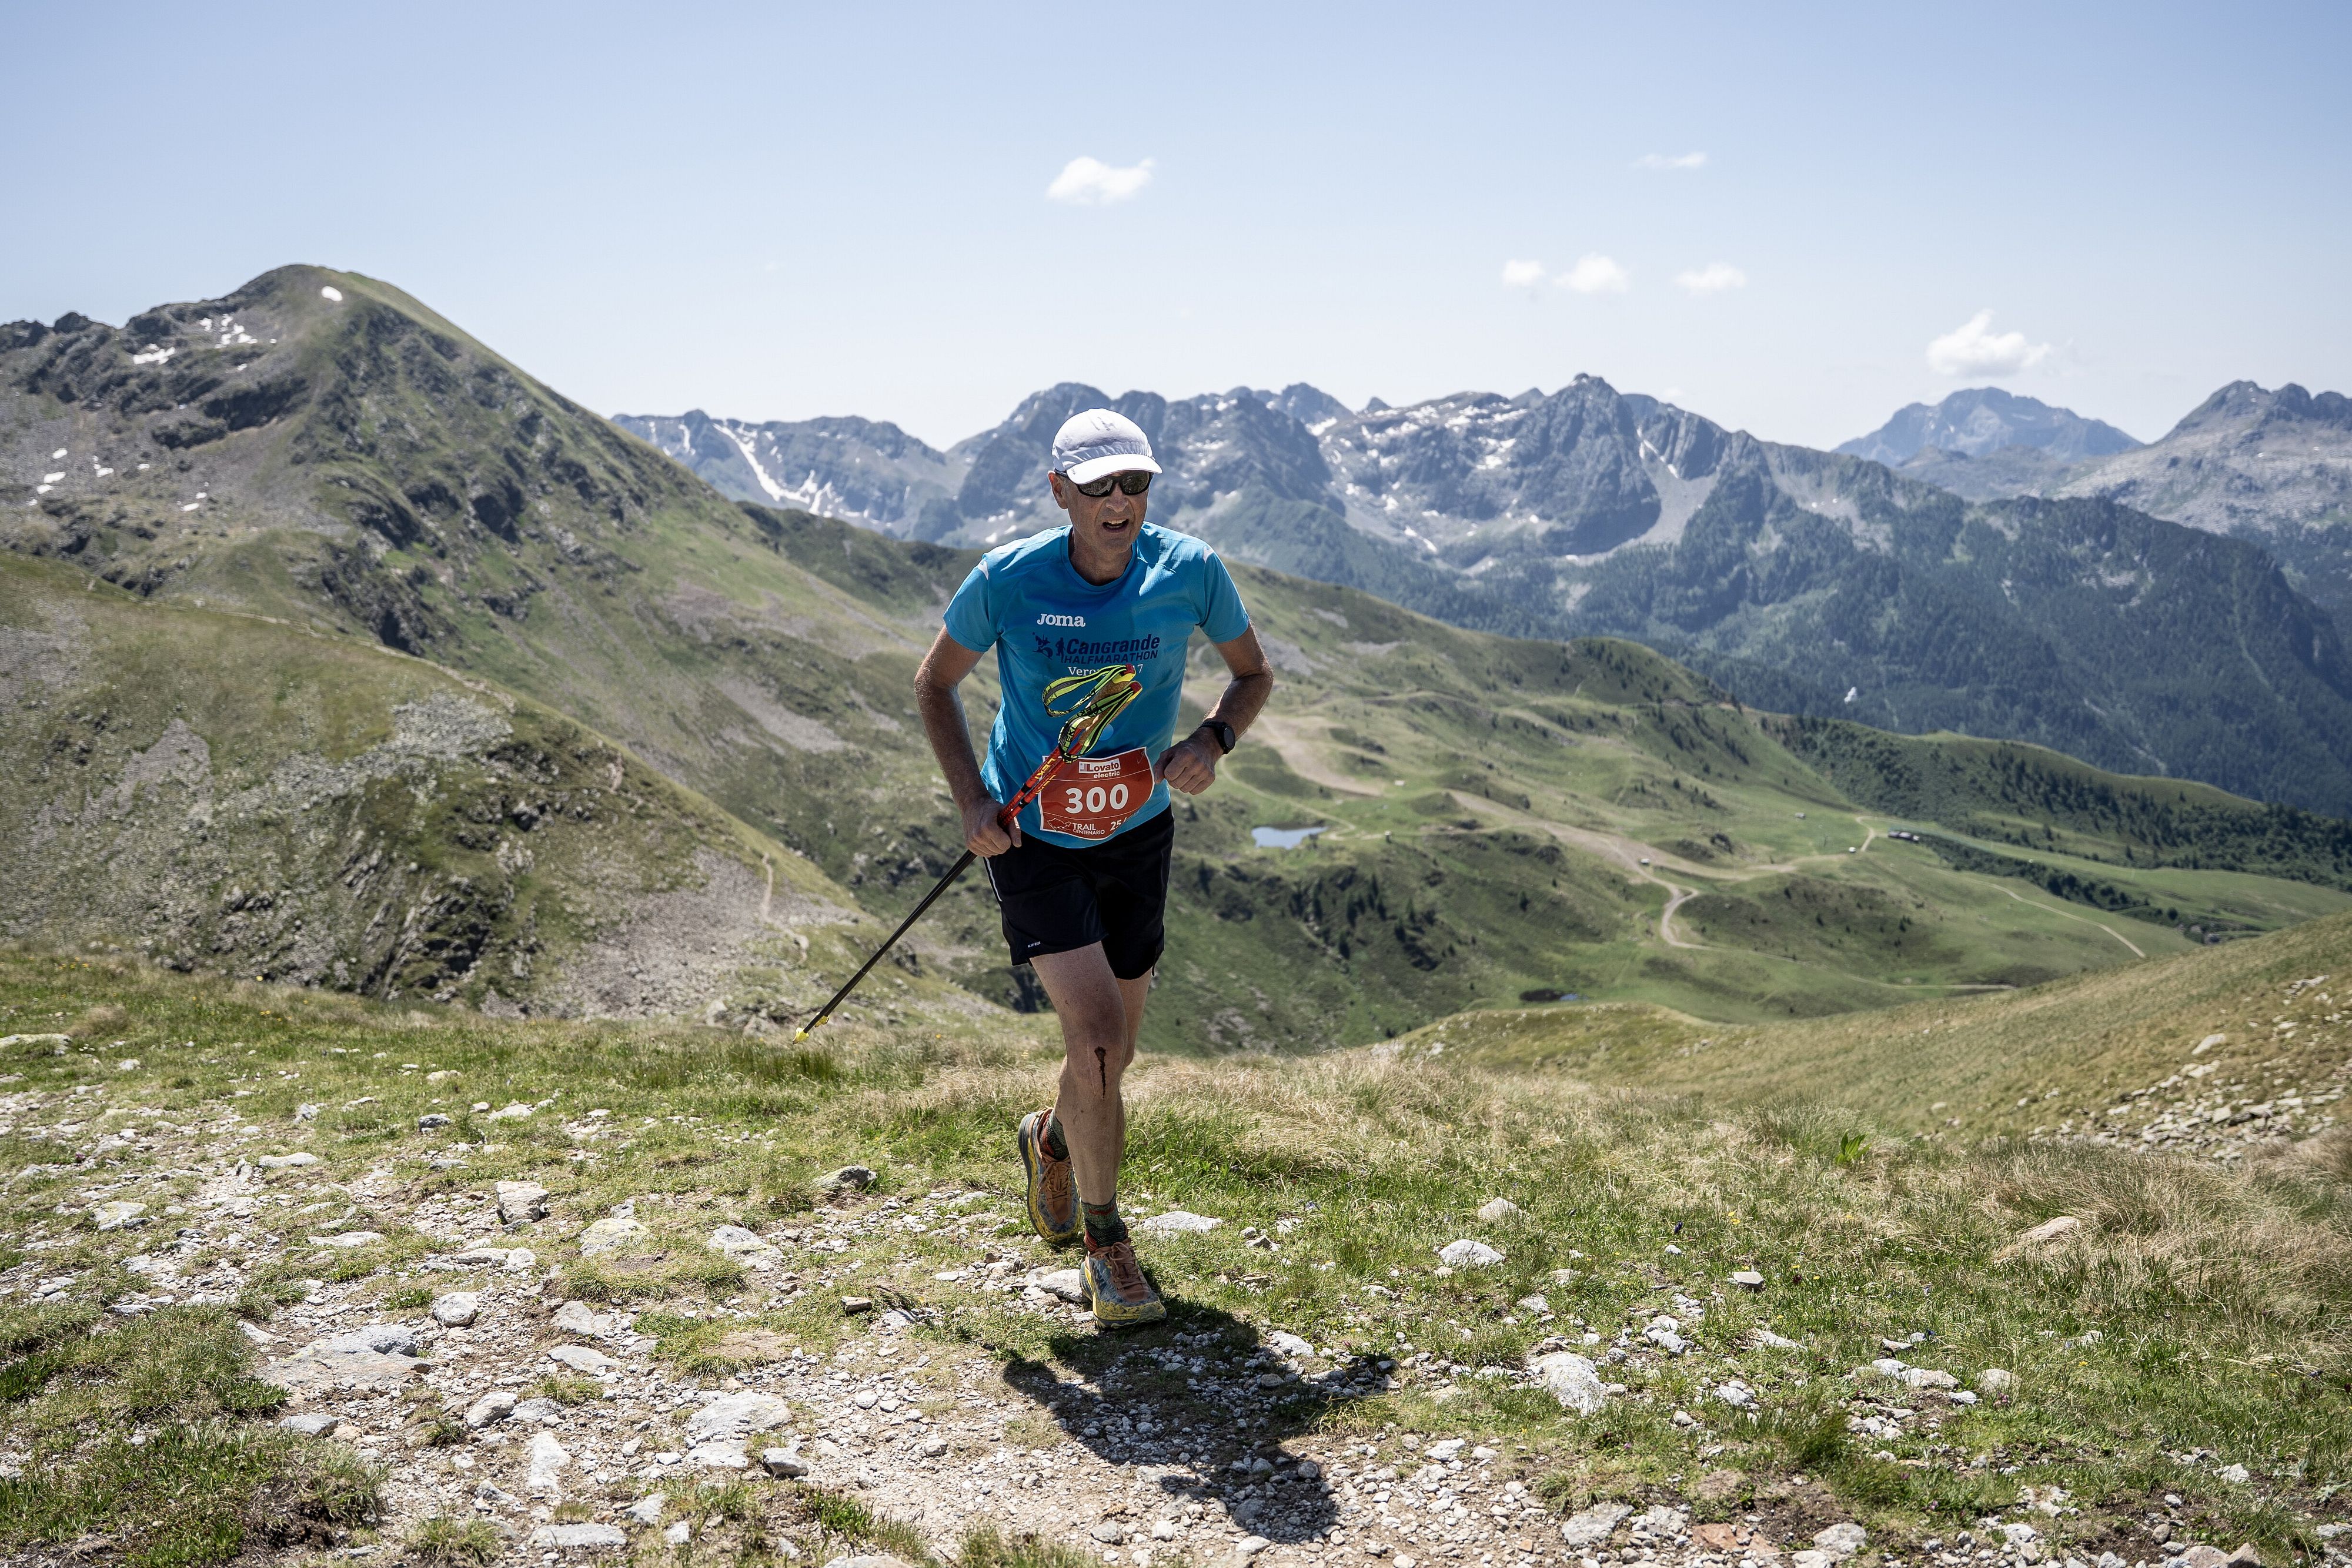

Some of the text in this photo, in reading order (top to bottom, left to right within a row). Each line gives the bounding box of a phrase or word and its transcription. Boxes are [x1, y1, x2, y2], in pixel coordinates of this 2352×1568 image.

[1037, 613, 1086, 627] Joma
[1066, 633, 1160, 654] Cangrande
[1064, 650, 1158, 664] HALFMARATHON
[1087, 762, 1120, 772] Lovato
[1065, 784, 1128, 814] 300
[1073, 823, 1097, 831] TRAIL
